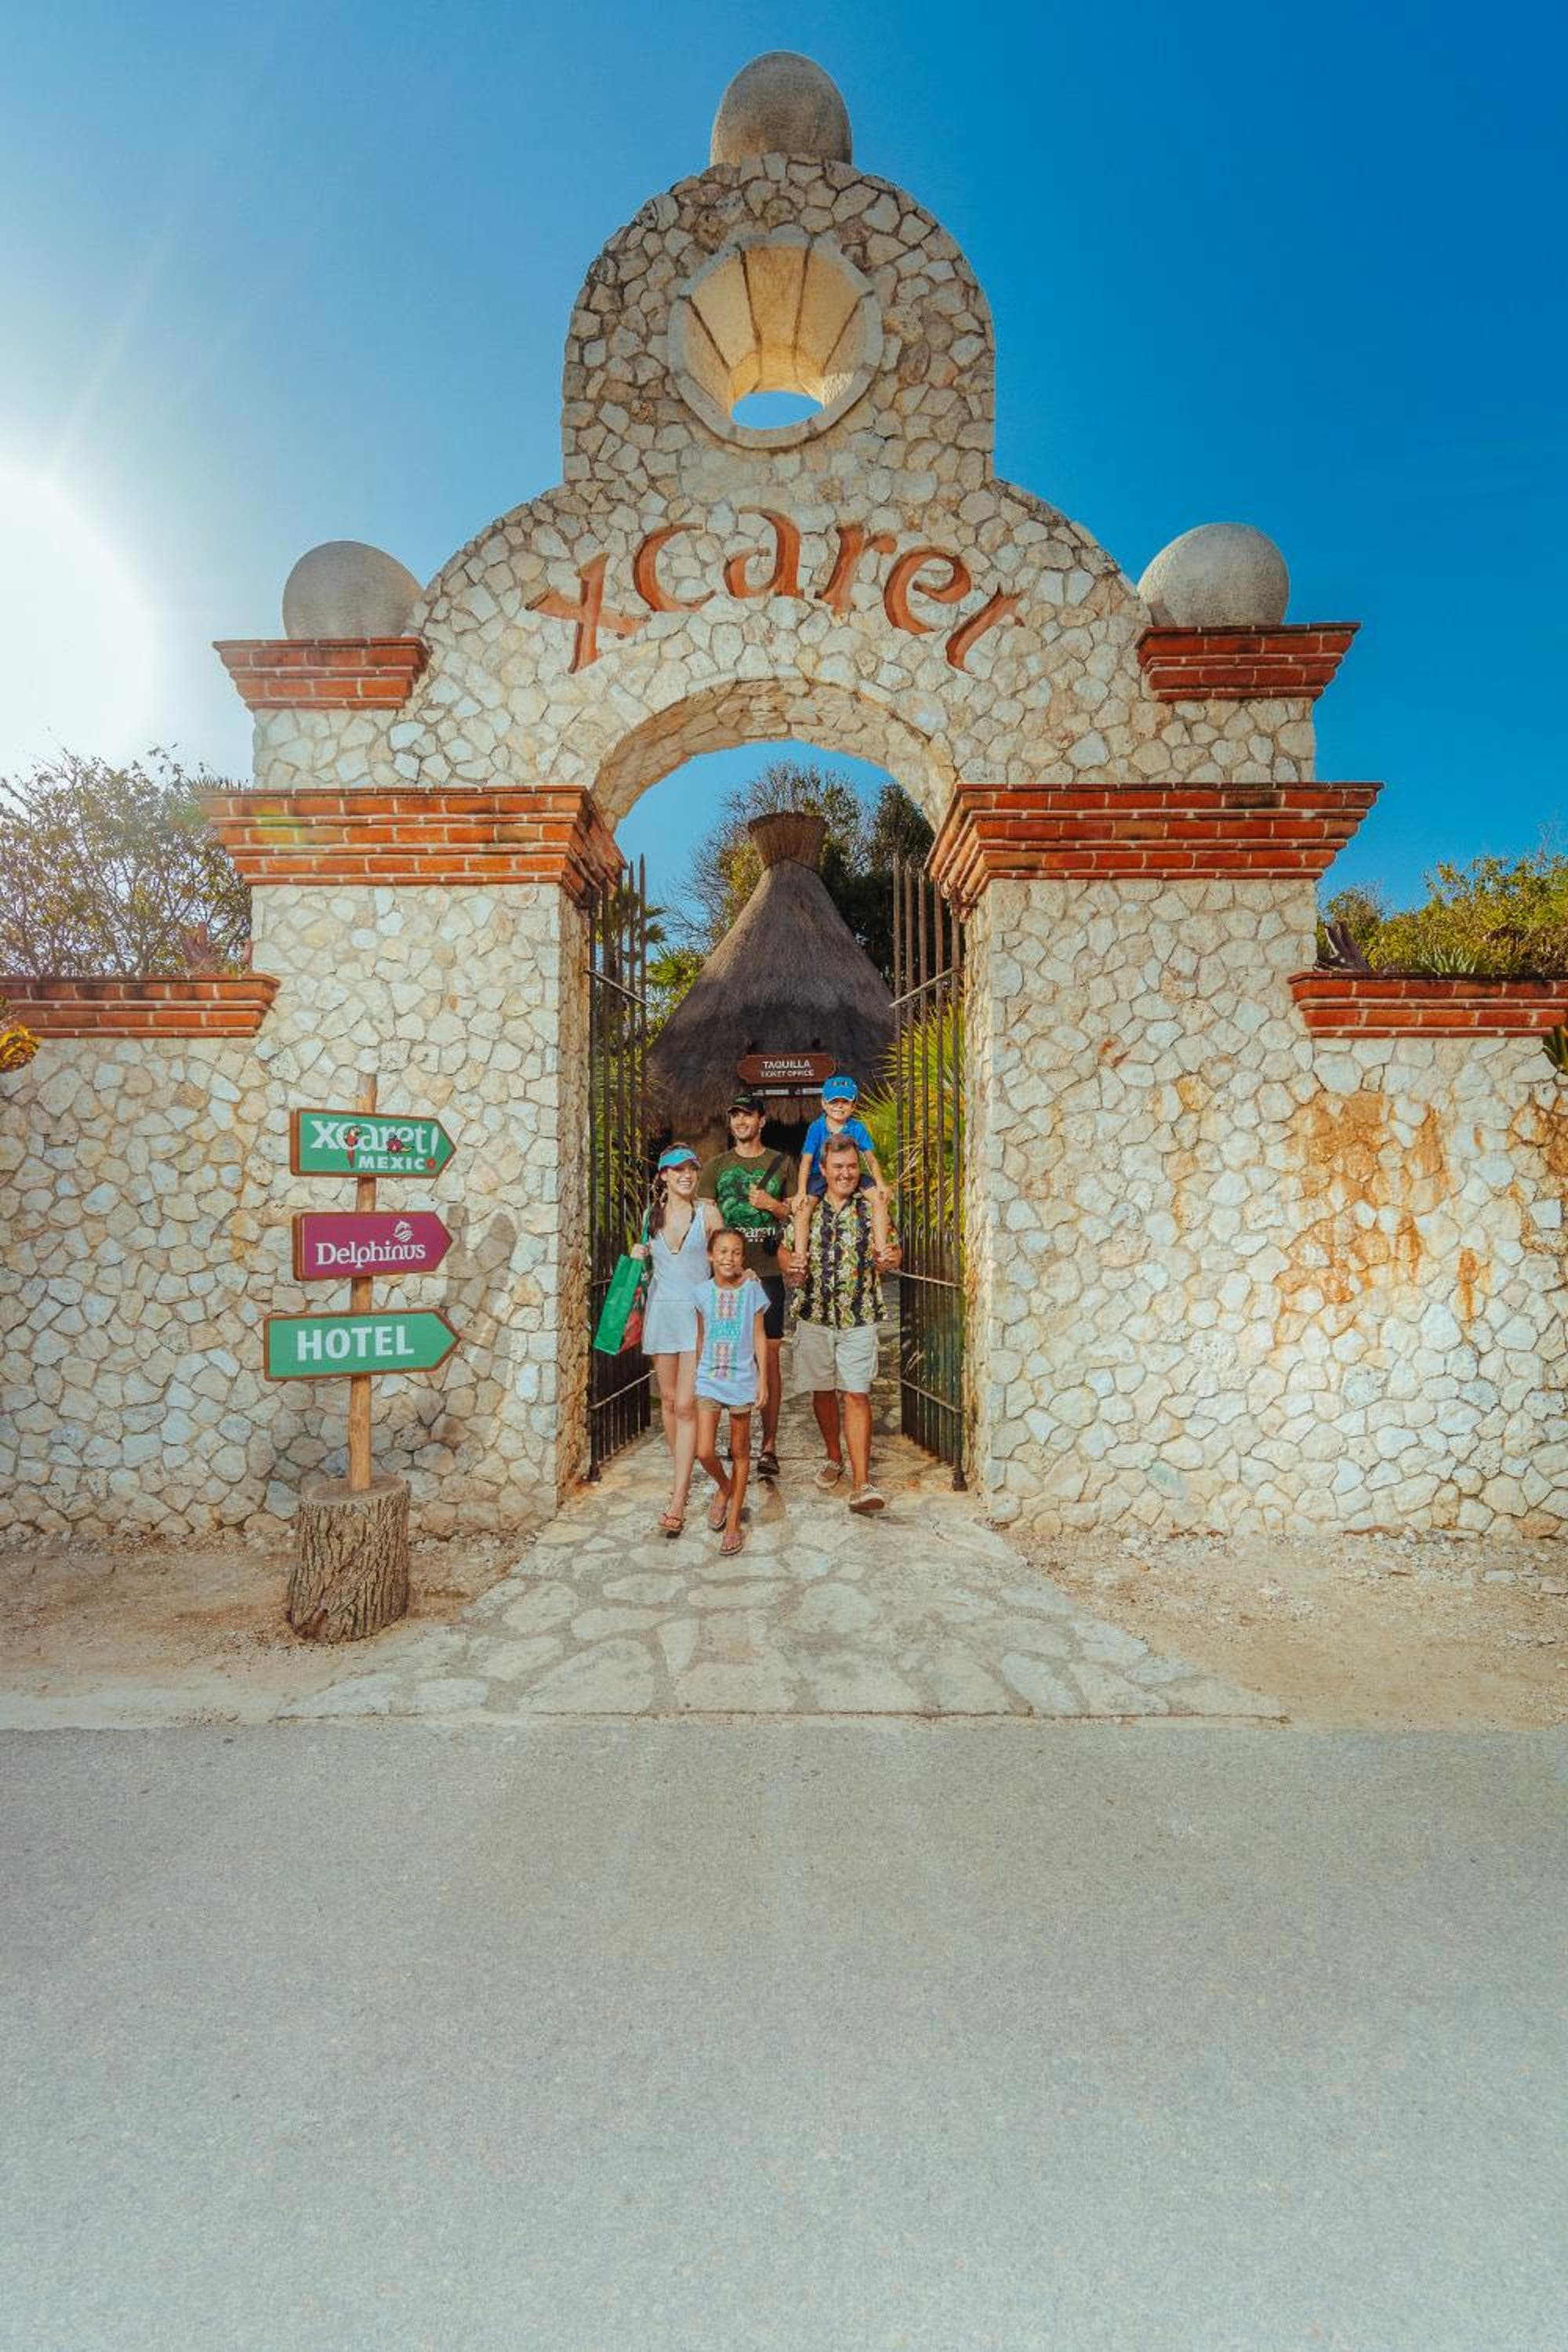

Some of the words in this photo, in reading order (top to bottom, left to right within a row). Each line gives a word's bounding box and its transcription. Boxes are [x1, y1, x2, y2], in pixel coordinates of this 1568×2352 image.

[762, 1060, 811, 1069] TAQUILLA
[315, 1240, 426, 1269] Delphinus
[297, 1325, 415, 1361] HOTEL
